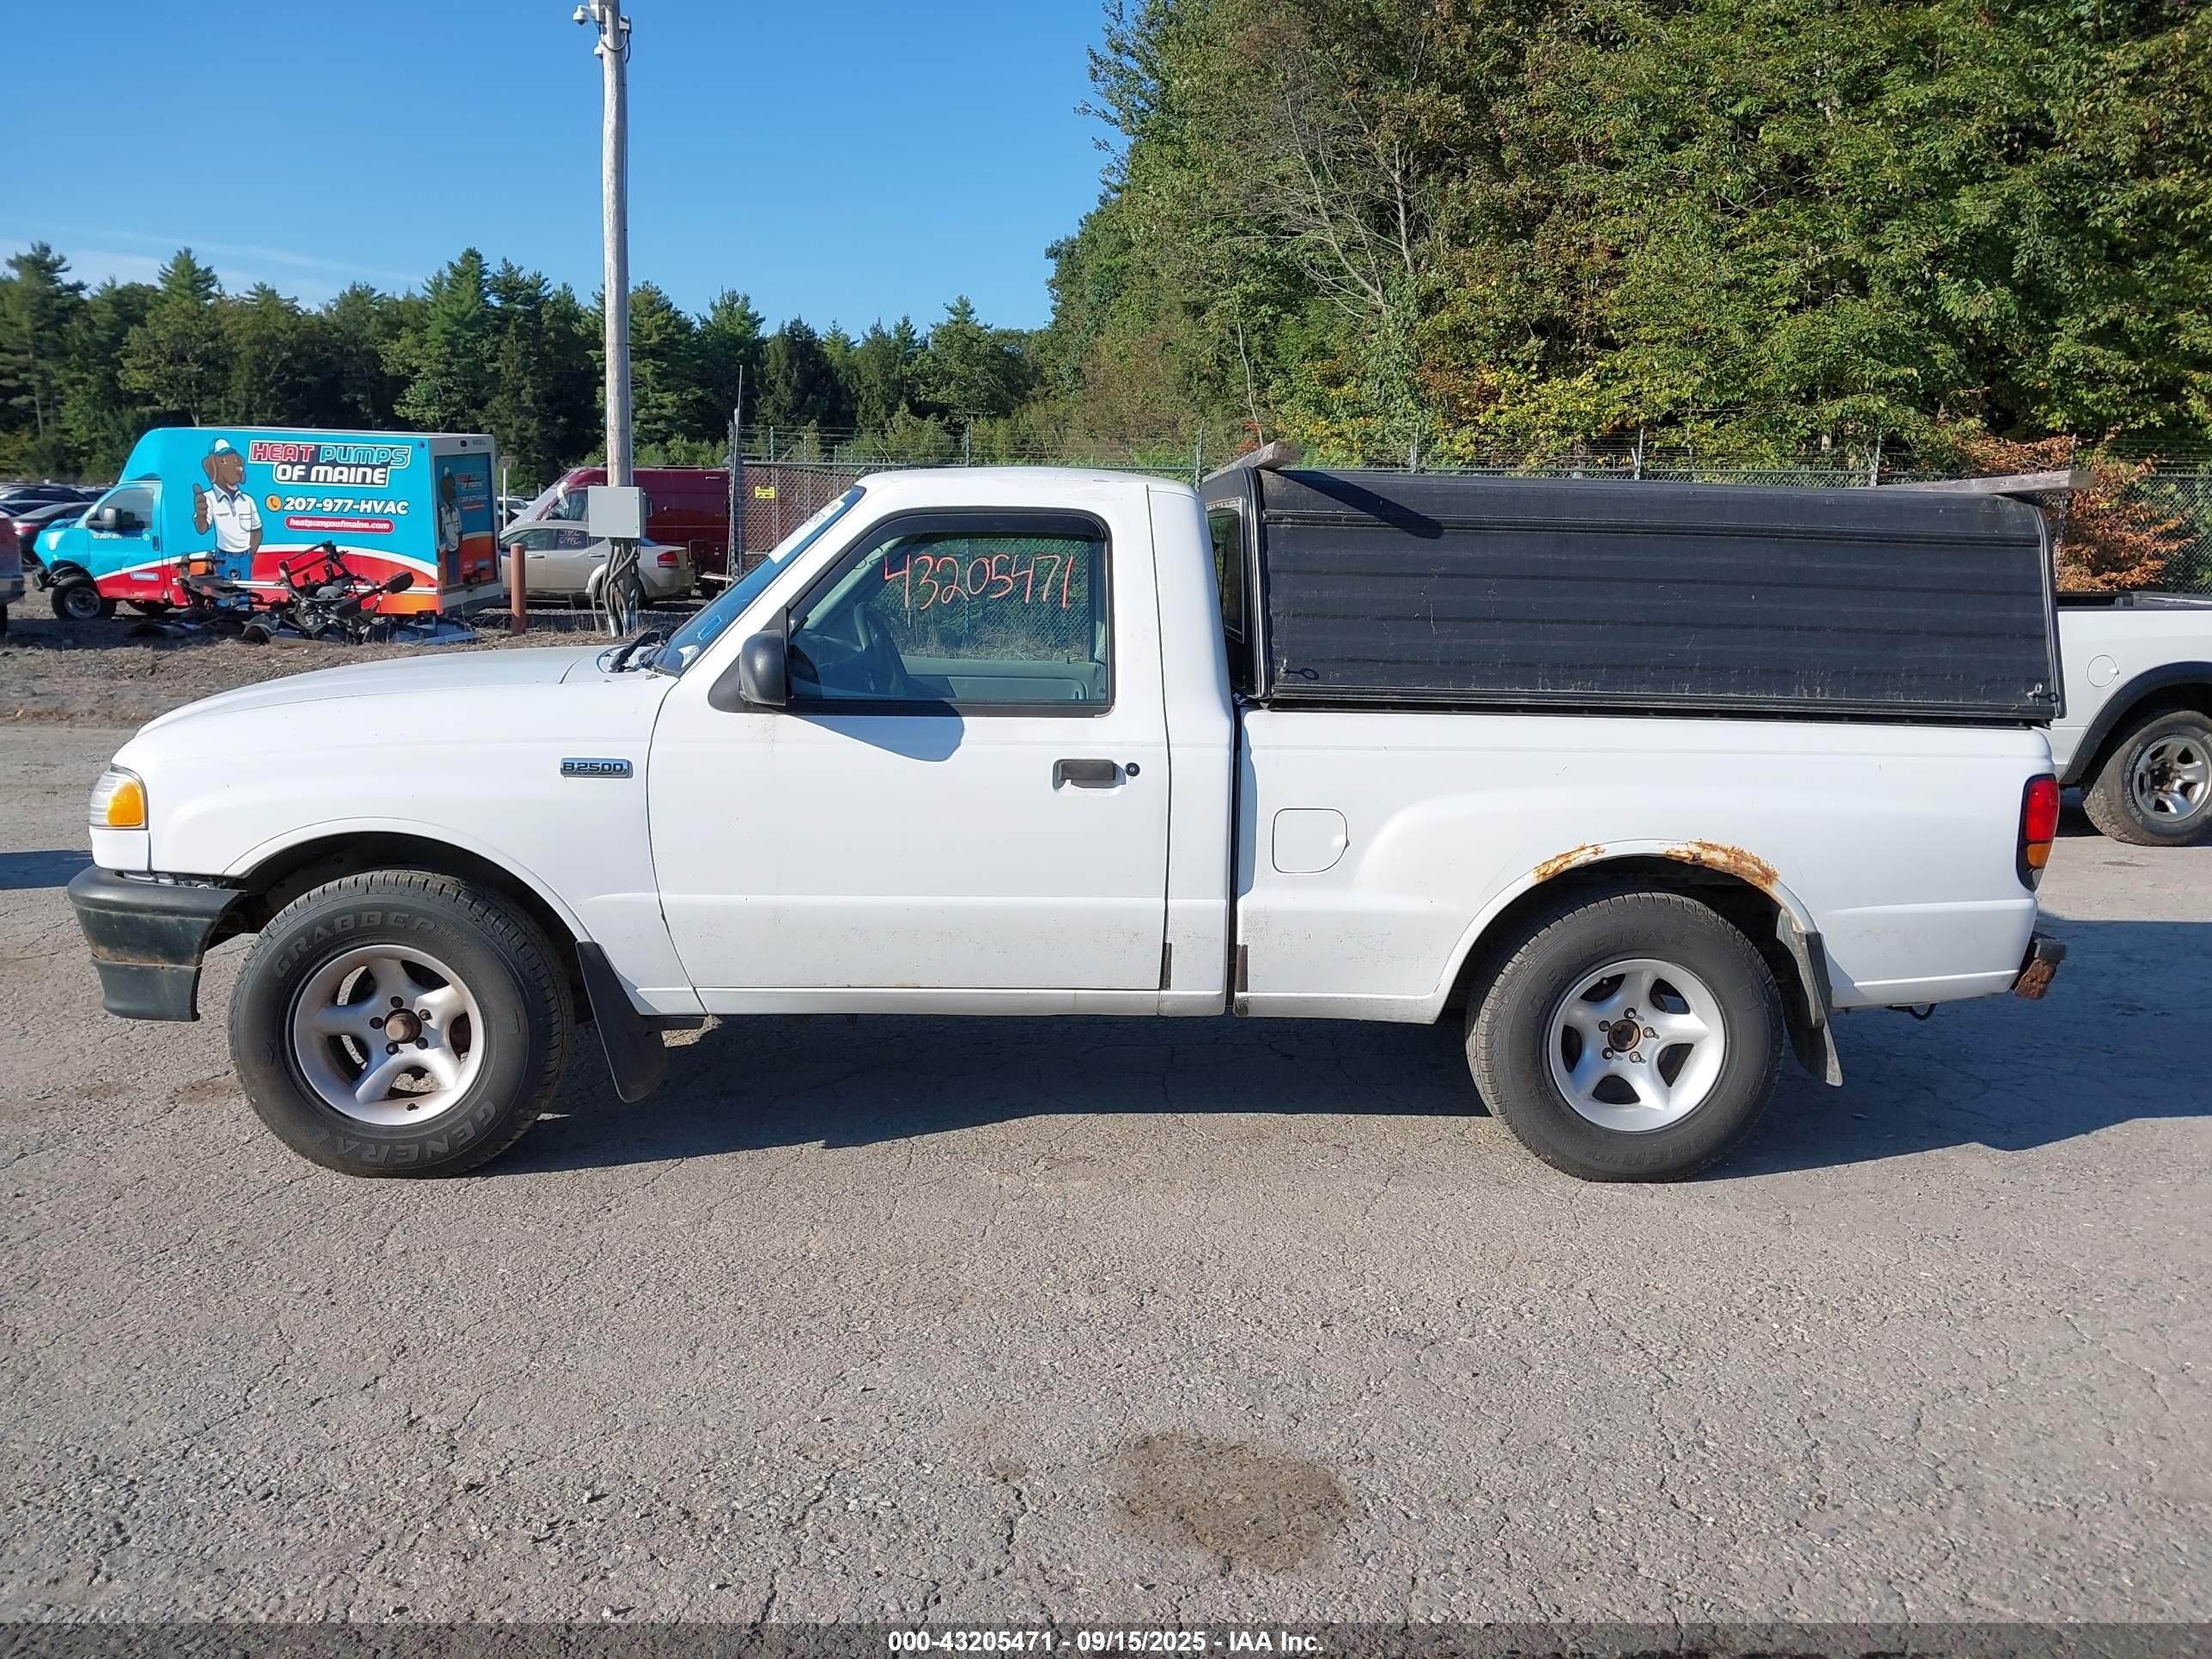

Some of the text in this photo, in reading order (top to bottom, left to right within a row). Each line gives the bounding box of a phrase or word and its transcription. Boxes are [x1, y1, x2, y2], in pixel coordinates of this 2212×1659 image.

[251, 443, 410, 466] HEAT PUMPS
[275, 464, 387, 484] OF MAINE
[283, 496, 410, 515] 207-977-HVAC
[289, 518, 390, 531] heatpumpsofmaine.com
[884, 553, 1074, 610] 43205471
[562, 762, 624, 773] B2500
[273, 910, 438, 978] GRABBER
